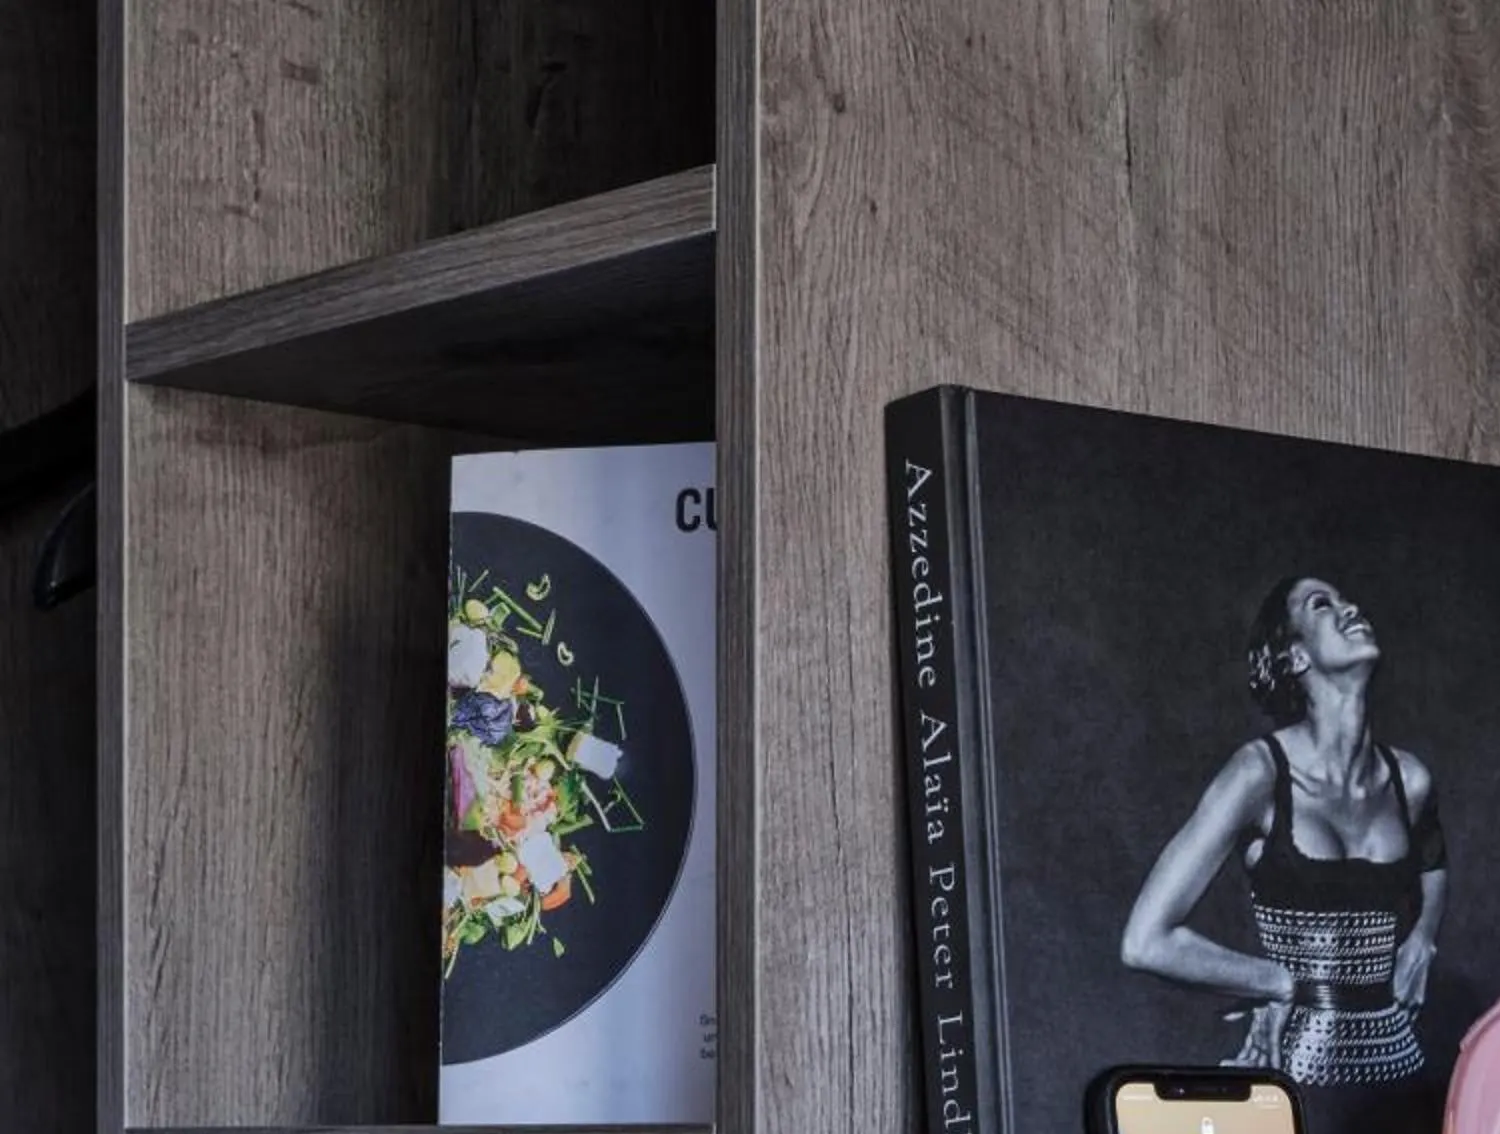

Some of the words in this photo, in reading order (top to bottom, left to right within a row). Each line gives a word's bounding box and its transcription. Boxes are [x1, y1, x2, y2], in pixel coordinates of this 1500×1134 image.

[905, 458, 942, 689] Azzedine
[920, 709, 952, 844] Alaïa
[929, 862, 955, 990] Peter
